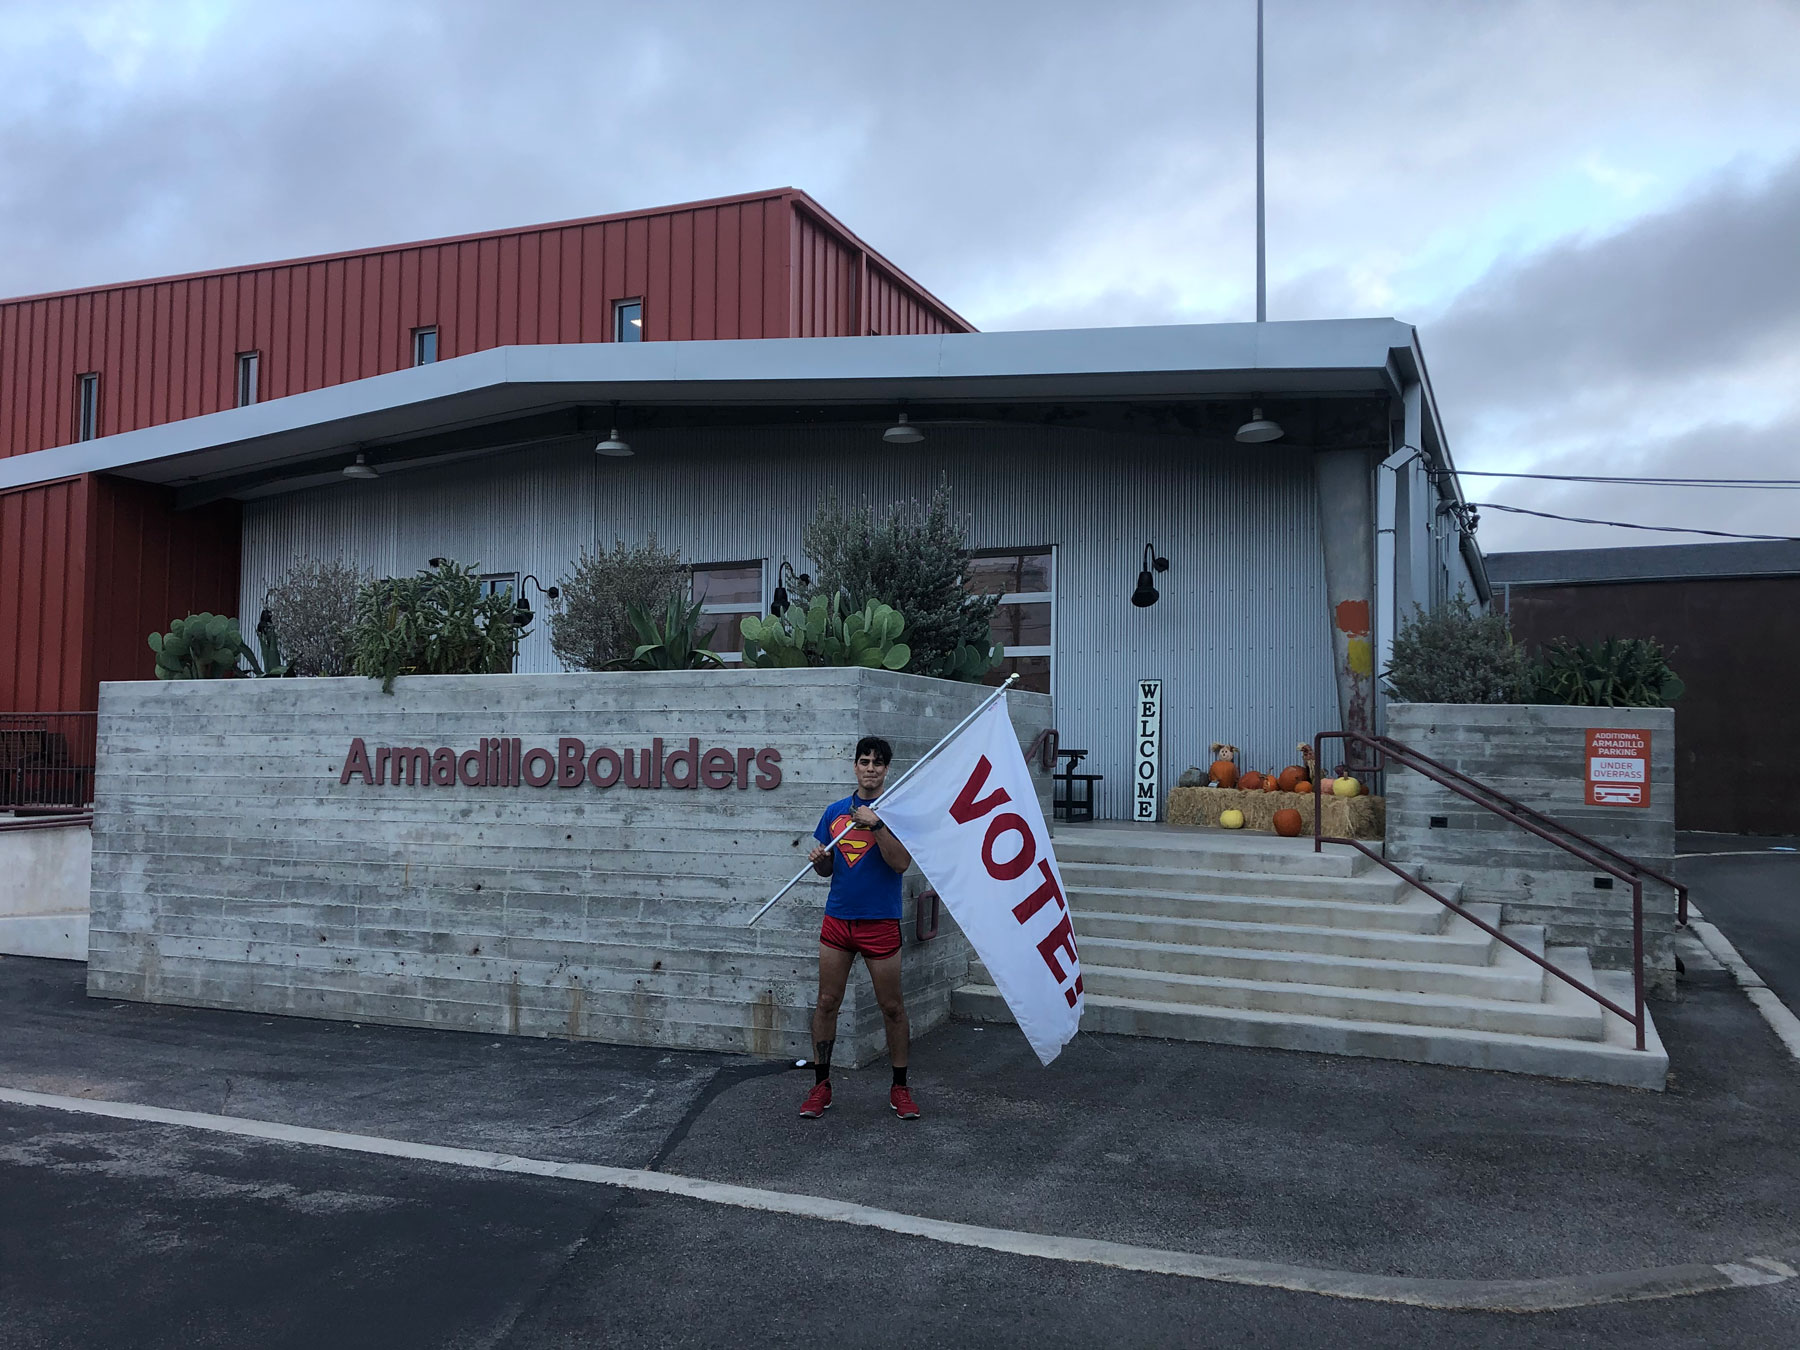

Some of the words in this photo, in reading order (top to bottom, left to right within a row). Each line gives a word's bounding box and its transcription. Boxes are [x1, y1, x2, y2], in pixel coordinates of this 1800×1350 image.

[1592, 740, 1644, 748] ARMADILLO
[1137, 683, 1158, 817] WELCOME
[1598, 748, 1637, 756] PARKING
[340, 737, 782, 790] ArmadilloBoulders
[1594, 770, 1642, 779] OVERPASS
